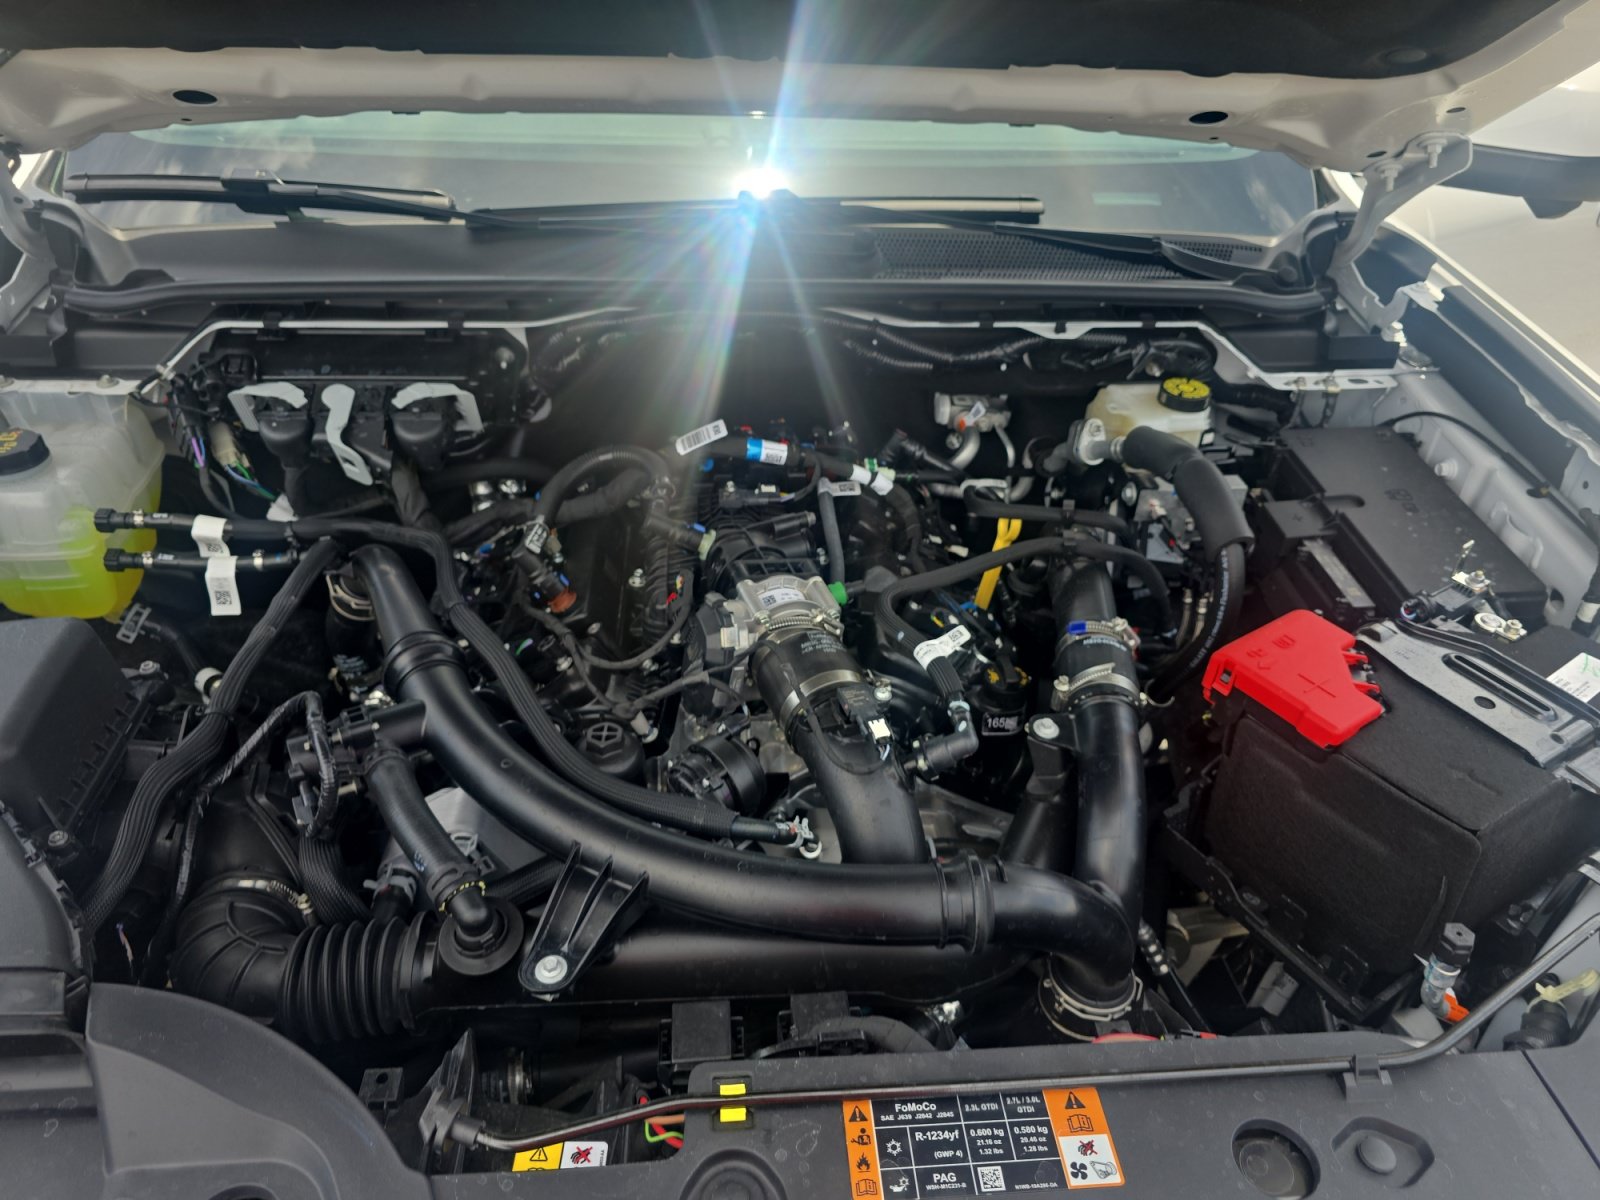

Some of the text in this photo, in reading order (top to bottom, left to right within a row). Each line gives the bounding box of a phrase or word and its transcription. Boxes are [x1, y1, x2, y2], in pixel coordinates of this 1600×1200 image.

[894, 1101, 937, 1112] FoMoCo
[980, 1102, 998, 1111] GTDI
[1017, 1105, 1035, 1113] GTDI
[969, 1127, 1004, 1137] 0.600 kg
[1013, 1125, 1048, 1134] 0.580 kg
[915, 1129, 959, 1141] R-1234yf
[934, 1149, 963, 1160] (GWP 4)
[932, 1172, 957, 1183] PAG
